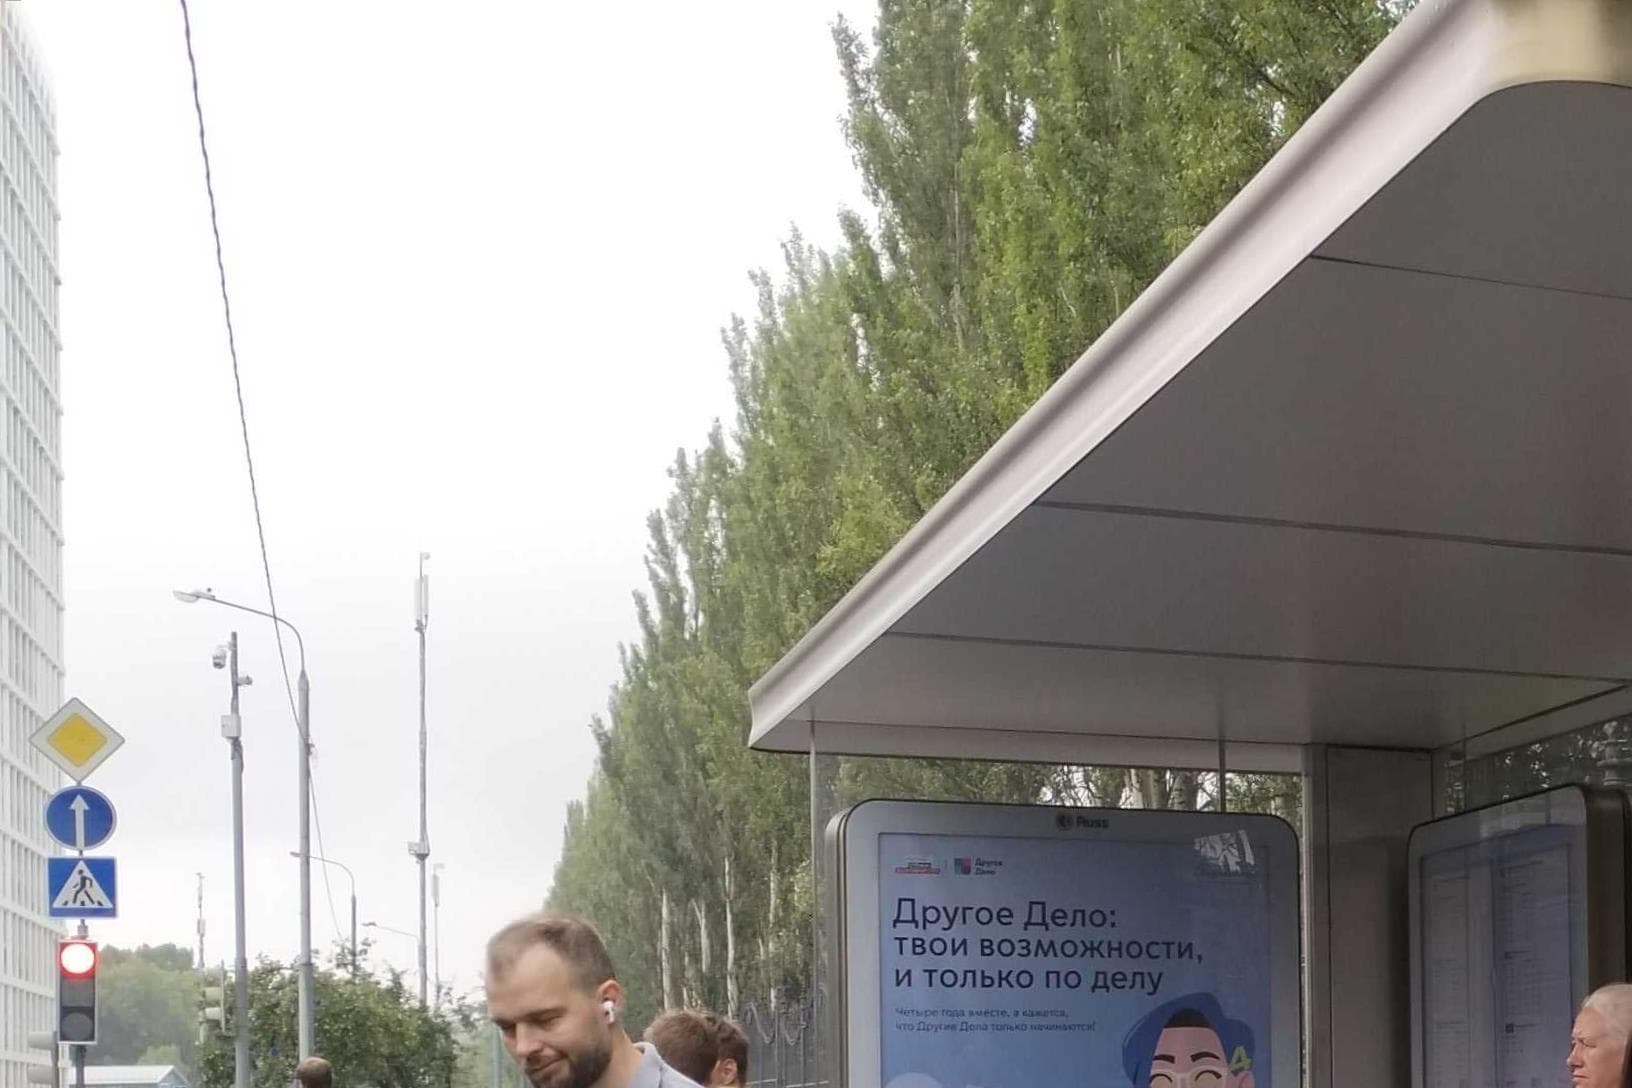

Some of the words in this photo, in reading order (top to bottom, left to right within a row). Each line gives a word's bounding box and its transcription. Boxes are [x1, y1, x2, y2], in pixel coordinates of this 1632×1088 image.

[892, 897, 1015, 932] Другое
[1023, 900, 1117, 931] Дело:
[893, 937, 969, 957] твои
[980, 938, 1203, 964] возможности,
[895, 968, 913, 988] и
[923, 968, 1034, 989] только
[1045, 969, 1082, 989] по
[1090, 971, 1164, 995] делу
